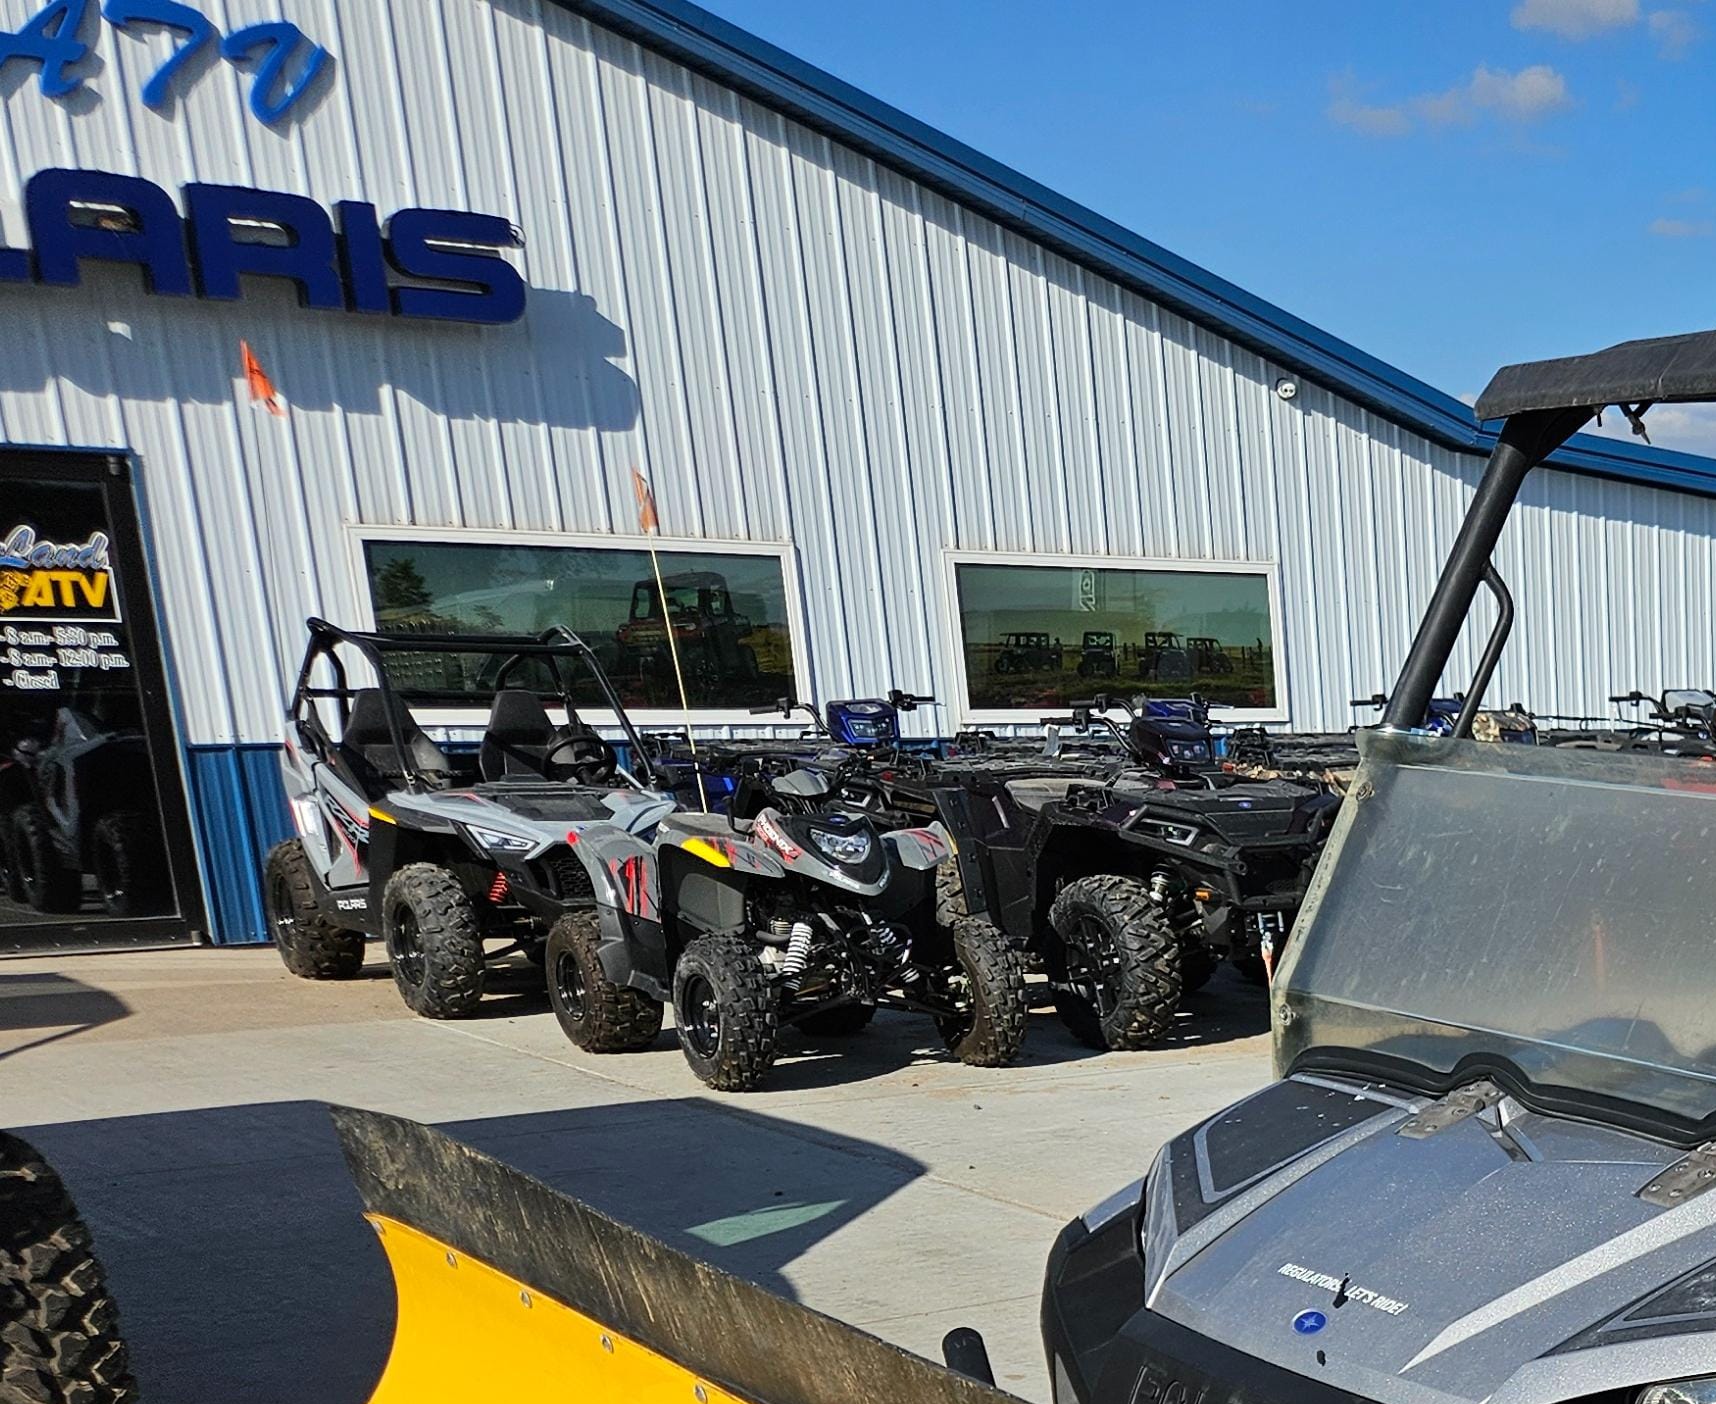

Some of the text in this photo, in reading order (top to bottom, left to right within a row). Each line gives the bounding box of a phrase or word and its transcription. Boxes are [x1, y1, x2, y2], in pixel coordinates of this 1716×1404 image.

[0, 0, 327, 124] ATV
[0, 168, 526, 324] ARIS
[22, 571, 109, 608] ATV
